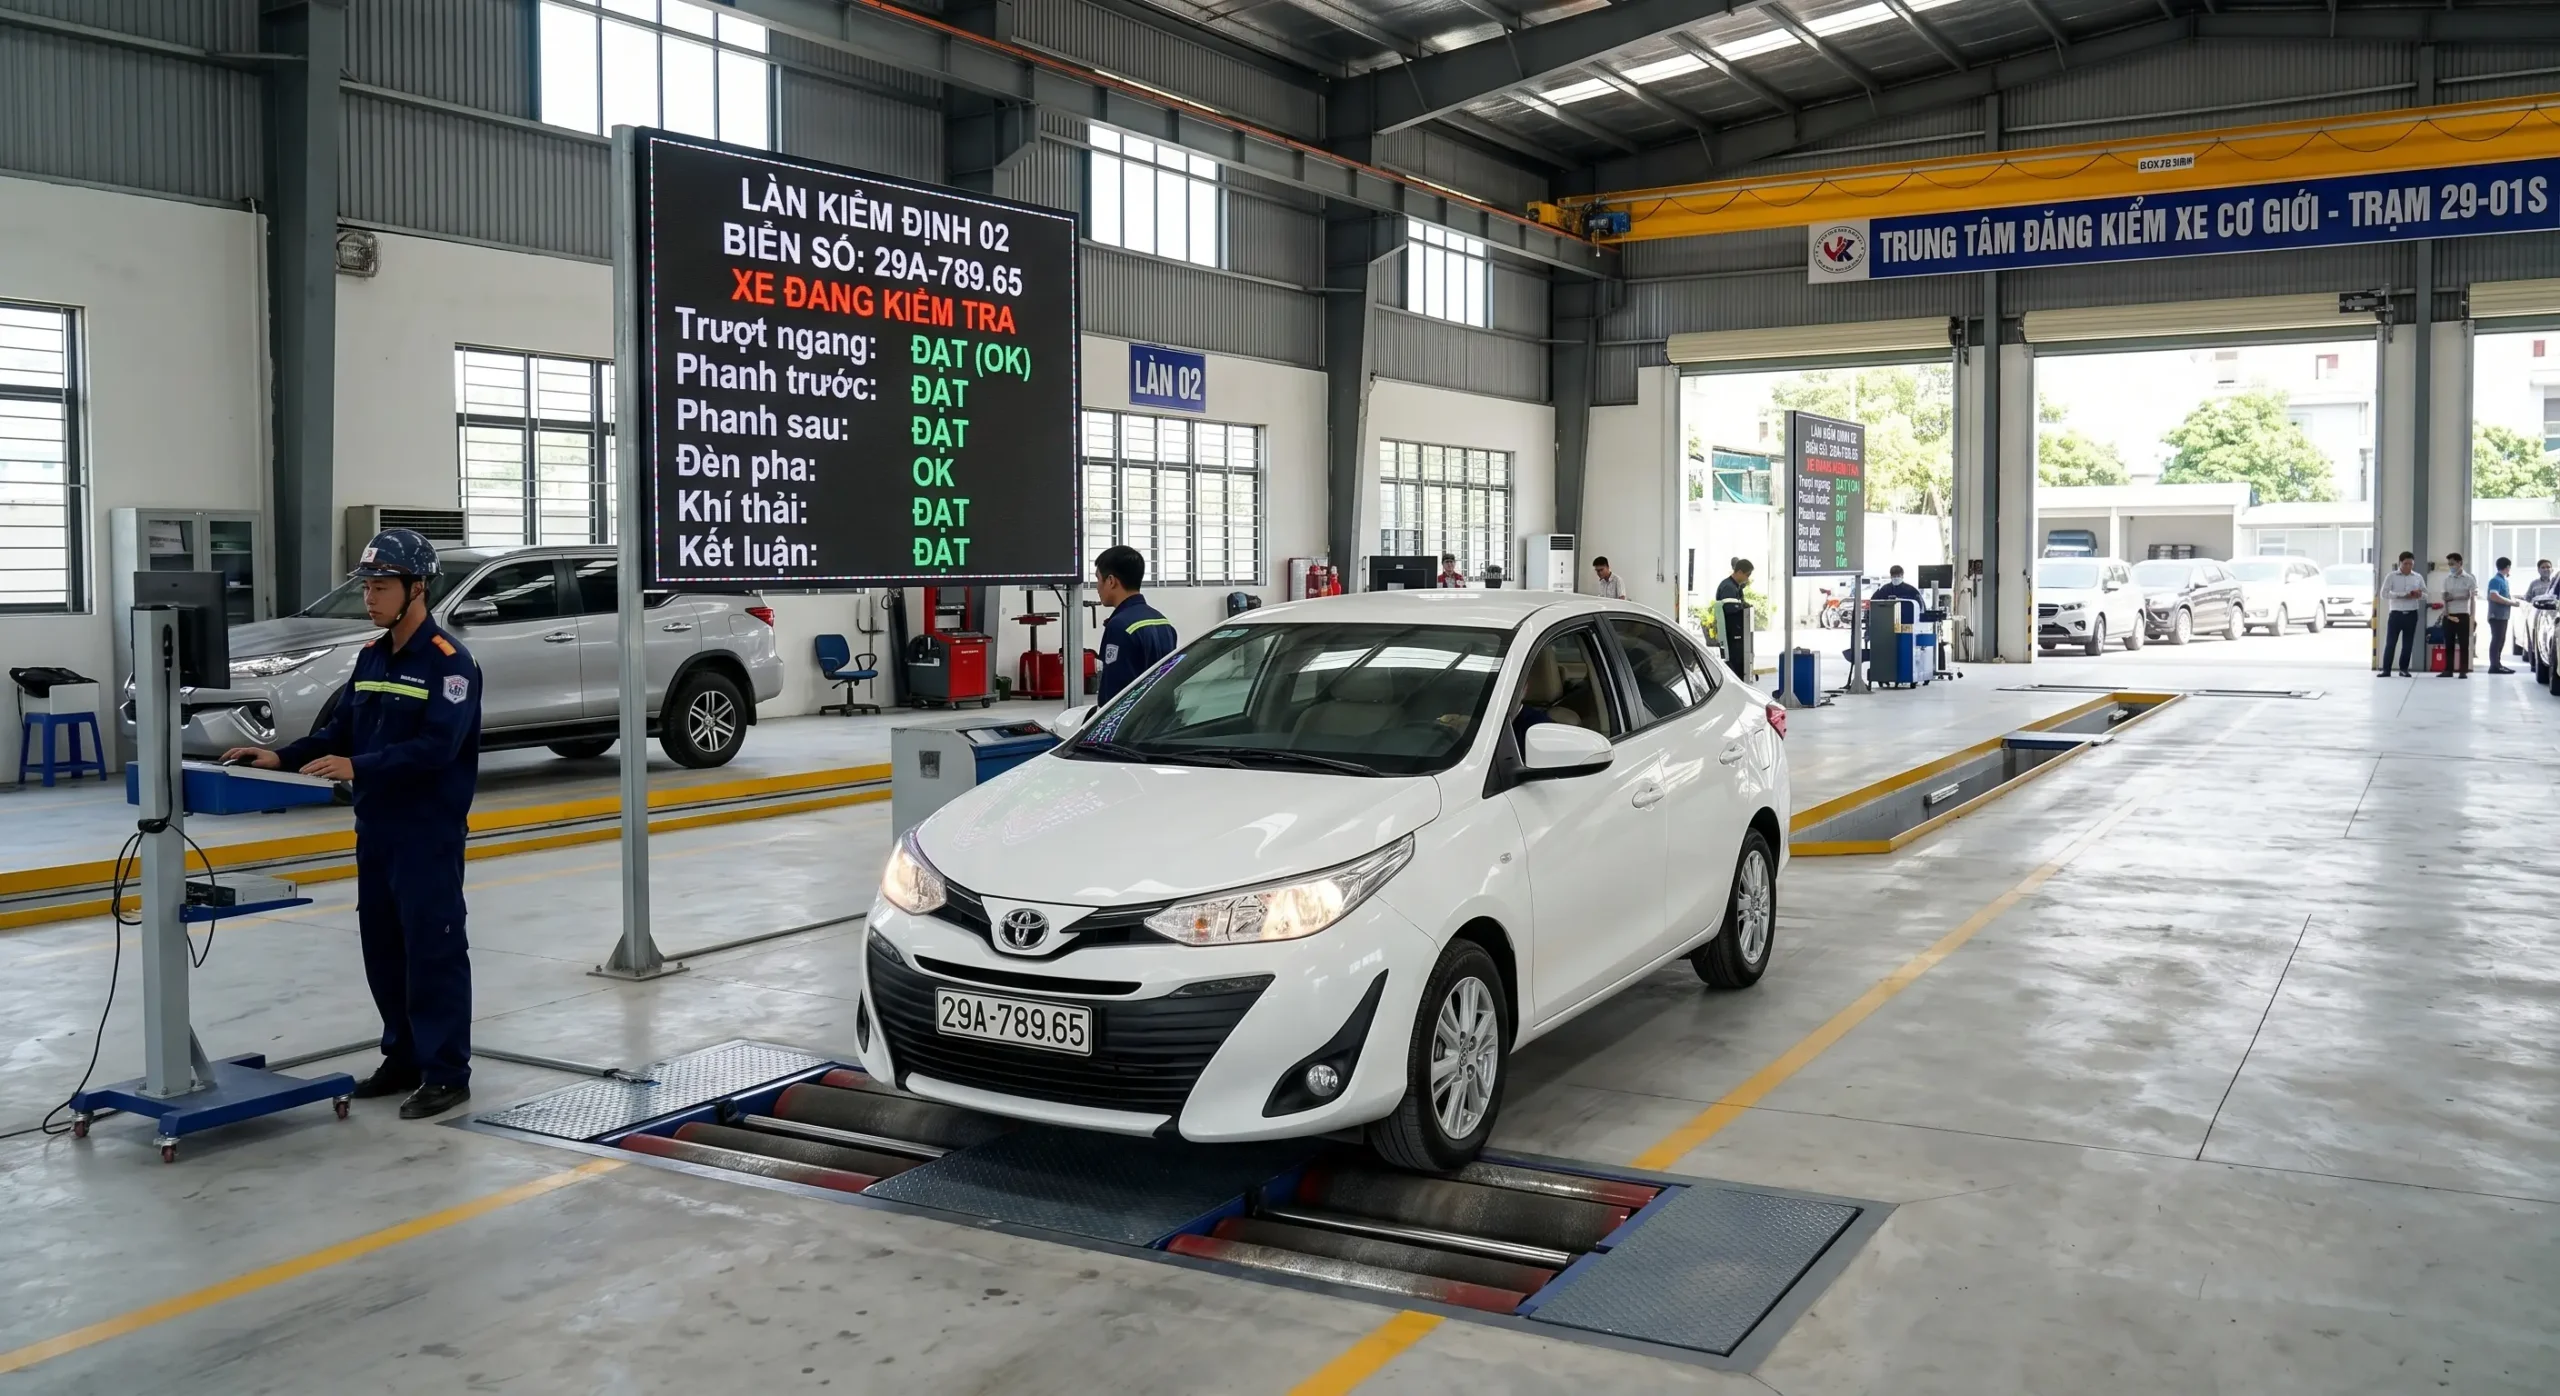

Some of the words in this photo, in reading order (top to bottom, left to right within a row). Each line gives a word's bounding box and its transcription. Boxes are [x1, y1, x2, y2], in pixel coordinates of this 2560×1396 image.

[742, 173, 806, 219] LÀN
[819, 189, 892, 233] KIỂM
[901, 205, 970, 247] ĐỊNH
[980, 220, 1009, 252] 02
[1880, 226, 1956, 263] TRUNG
[1965, 217, 2014, 256] TÂM
[2023, 210, 2092, 252] ĐĂNG
[2101, 196, 2165, 246] KIỂM
[2175, 205, 2208, 241] XE
[2217, 197, 2254, 237] CƠ
[2262, 188, 2319, 234] GIỚI
[2328, 210, 2339, 218] -
[2348, 186, 2430, 232] TRẠM
[2440, 176, 2548, 220] 29-01S
[724, 220, 800, 264] BIỂN
[812, 233, 863, 273] SỐ:
[875, 247, 1023, 297] 29A-789.65
[731, 268, 774, 304] XE
[783, 275, 874, 317] ĐANG
[883, 287, 953, 327] KIỂM
[961, 300, 1016, 335] TRA
[675, 306, 767, 353] Trượt
[778, 327, 876, 365] ngang:
[911, 334, 969, 373] ĐẠT
[975, 342, 1031, 382] (OK)
[677, 352, 776, 393] Phanh
[786, 365, 876, 400] trước:
[911, 374, 969, 413] ĐẠT
[1135, 354, 1173, 397] LÀN
[1178, 366, 1202, 400] 02
[678, 398, 777, 437] Phanh
[787, 415, 848, 445] sau:
[911, 415, 969, 453] ĐẠT
[676, 443, 740, 478] Đèn
[752, 449, 816, 487] pha:
[912, 456, 954, 487] OK
[679, 489, 731, 523] Khí
[741, 492, 807, 526] thải:
[912, 497, 970, 533] ĐẠT
[680, 526, 735, 567] Kết
[744, 535, 817, 574] luận:
[912, 537, 970, 573] ĐẠT
[942, 995, 1085, 1047] 29A-789.65
